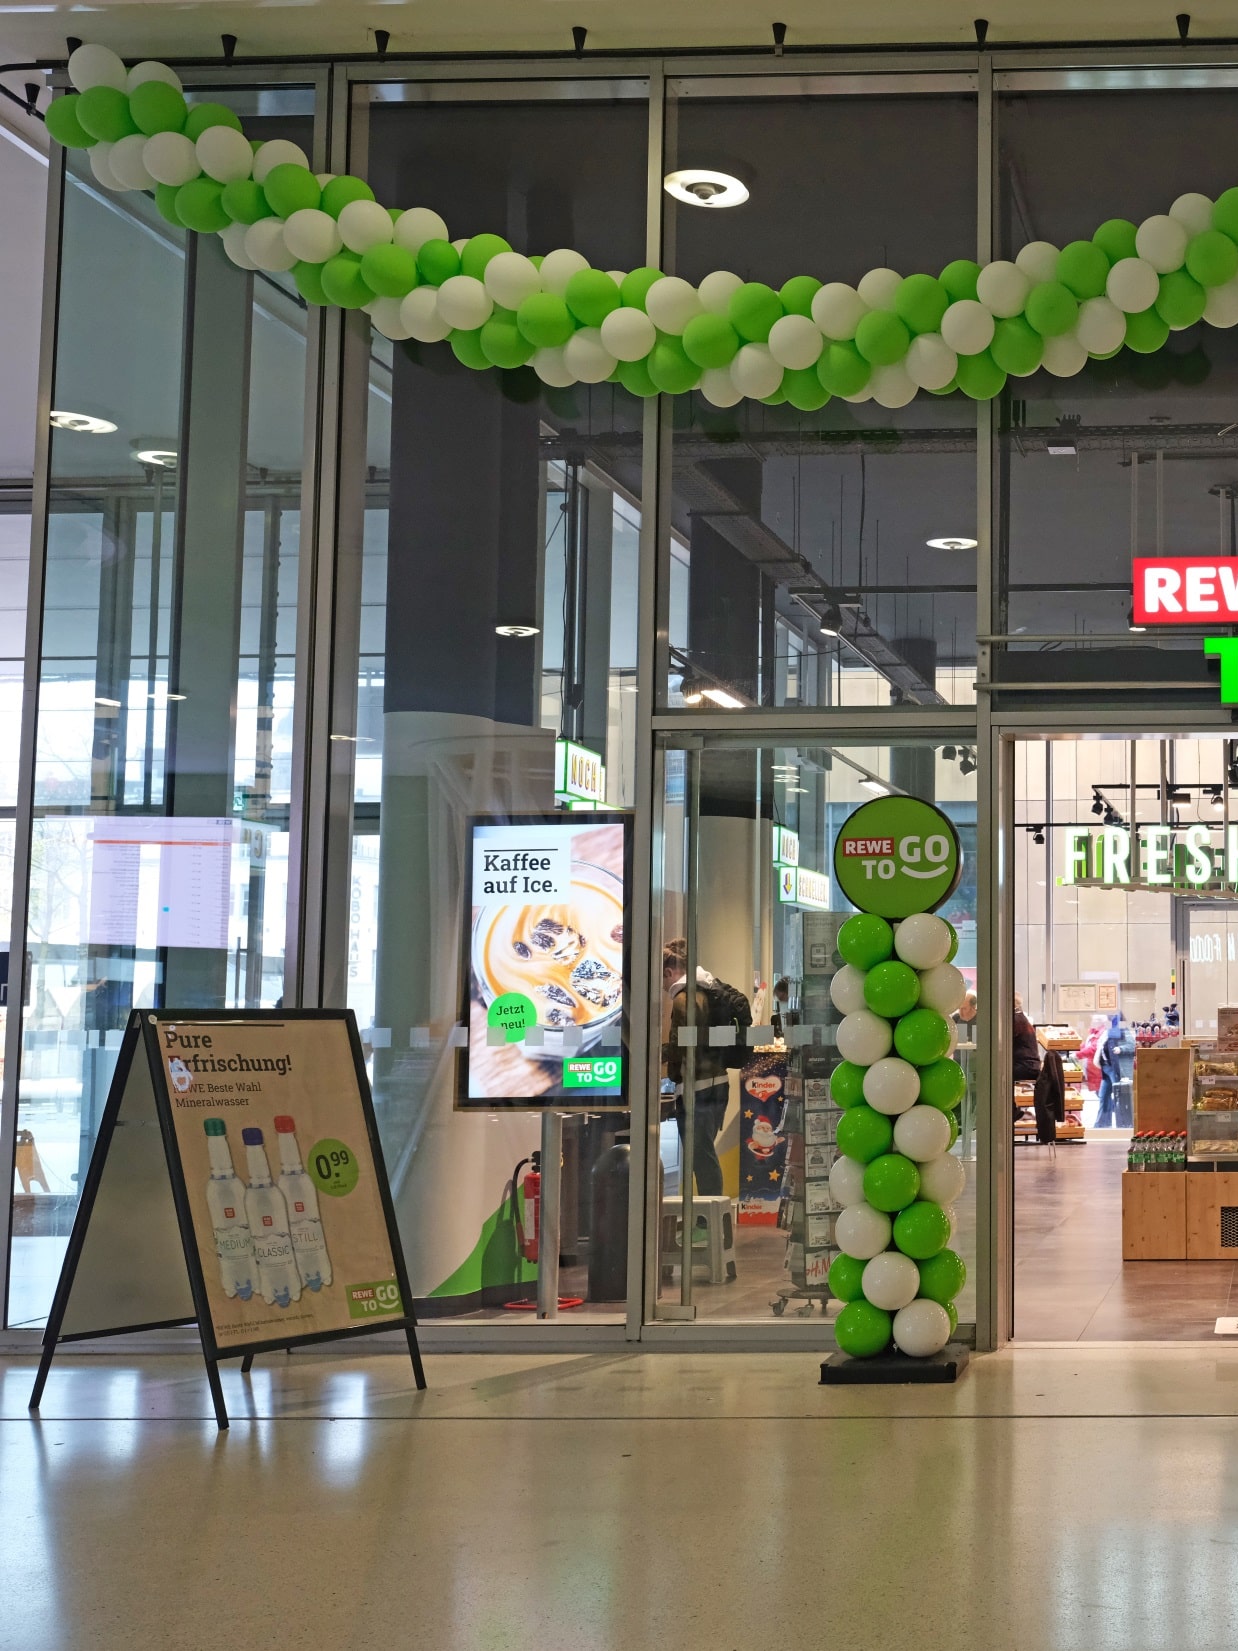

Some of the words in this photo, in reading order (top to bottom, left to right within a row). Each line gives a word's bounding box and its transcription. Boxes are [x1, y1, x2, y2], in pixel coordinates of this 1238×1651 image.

[845, 840, 892, 854] REWE
[899, 835, 950, 863] GO
[483, 853, 551, 872] Kaffee
[861, 859, 896, 879] TO
[483, 875, 518, 894] auf
[522, 876, 558, 893] Ice.
[496, 1004, 525, 1016] Jetzt
[500, 1018, 526, 1030] neu!
[164, 1031, 212, 1049] Pure
[168, 1054, 292, 1076] rfrischung!
[569, 1063, 591, 1071] REWE
[593, 1062, 617, 1075] GO
[577, 1073, 592, 1083] TO
[207, 1083, 234, 1093] Beste
[236, 1082, 262, 1092] Wahl
[175, 1097, 250, 1108] Mineralwasser
[219, 1238, 250, 1250] MEDIUM
[292, 1233, 319, 1244] STILL
[257, 1245, 290, 1258] CLASSIC
[352, 1289, 374, 1300] REWE
[375, 1284, 399, 1302] GO
[361, 1300, 377, 1312] TO
